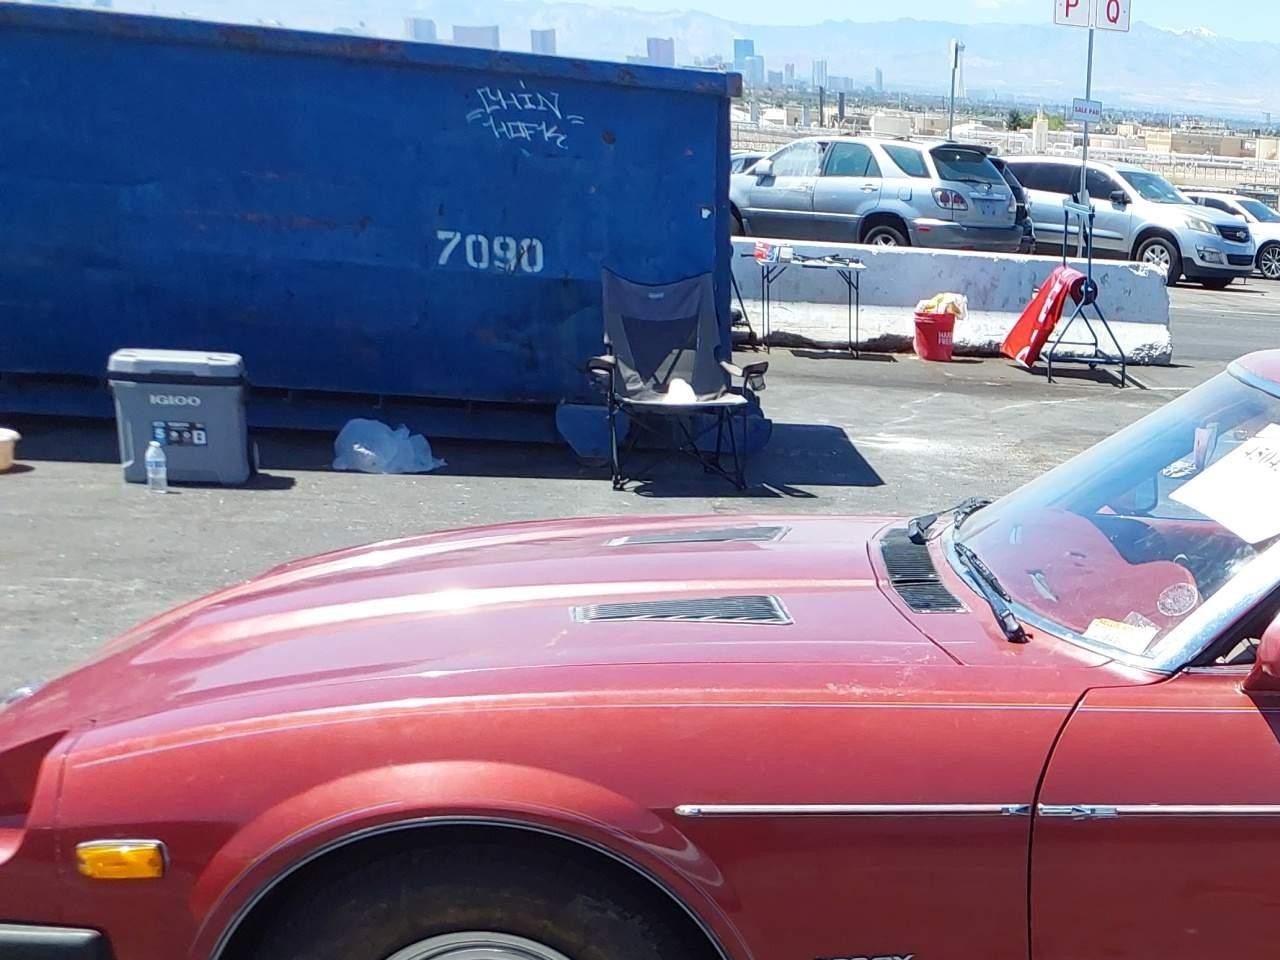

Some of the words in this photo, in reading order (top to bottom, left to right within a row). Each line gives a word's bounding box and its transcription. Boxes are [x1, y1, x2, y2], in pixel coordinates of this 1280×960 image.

[1065, 0, 1079, 17] P
[1106, 0, 1120, 24] Q
[436, 229, 544, 273] 7090
[149, 395, 201, 407] IGLOO
